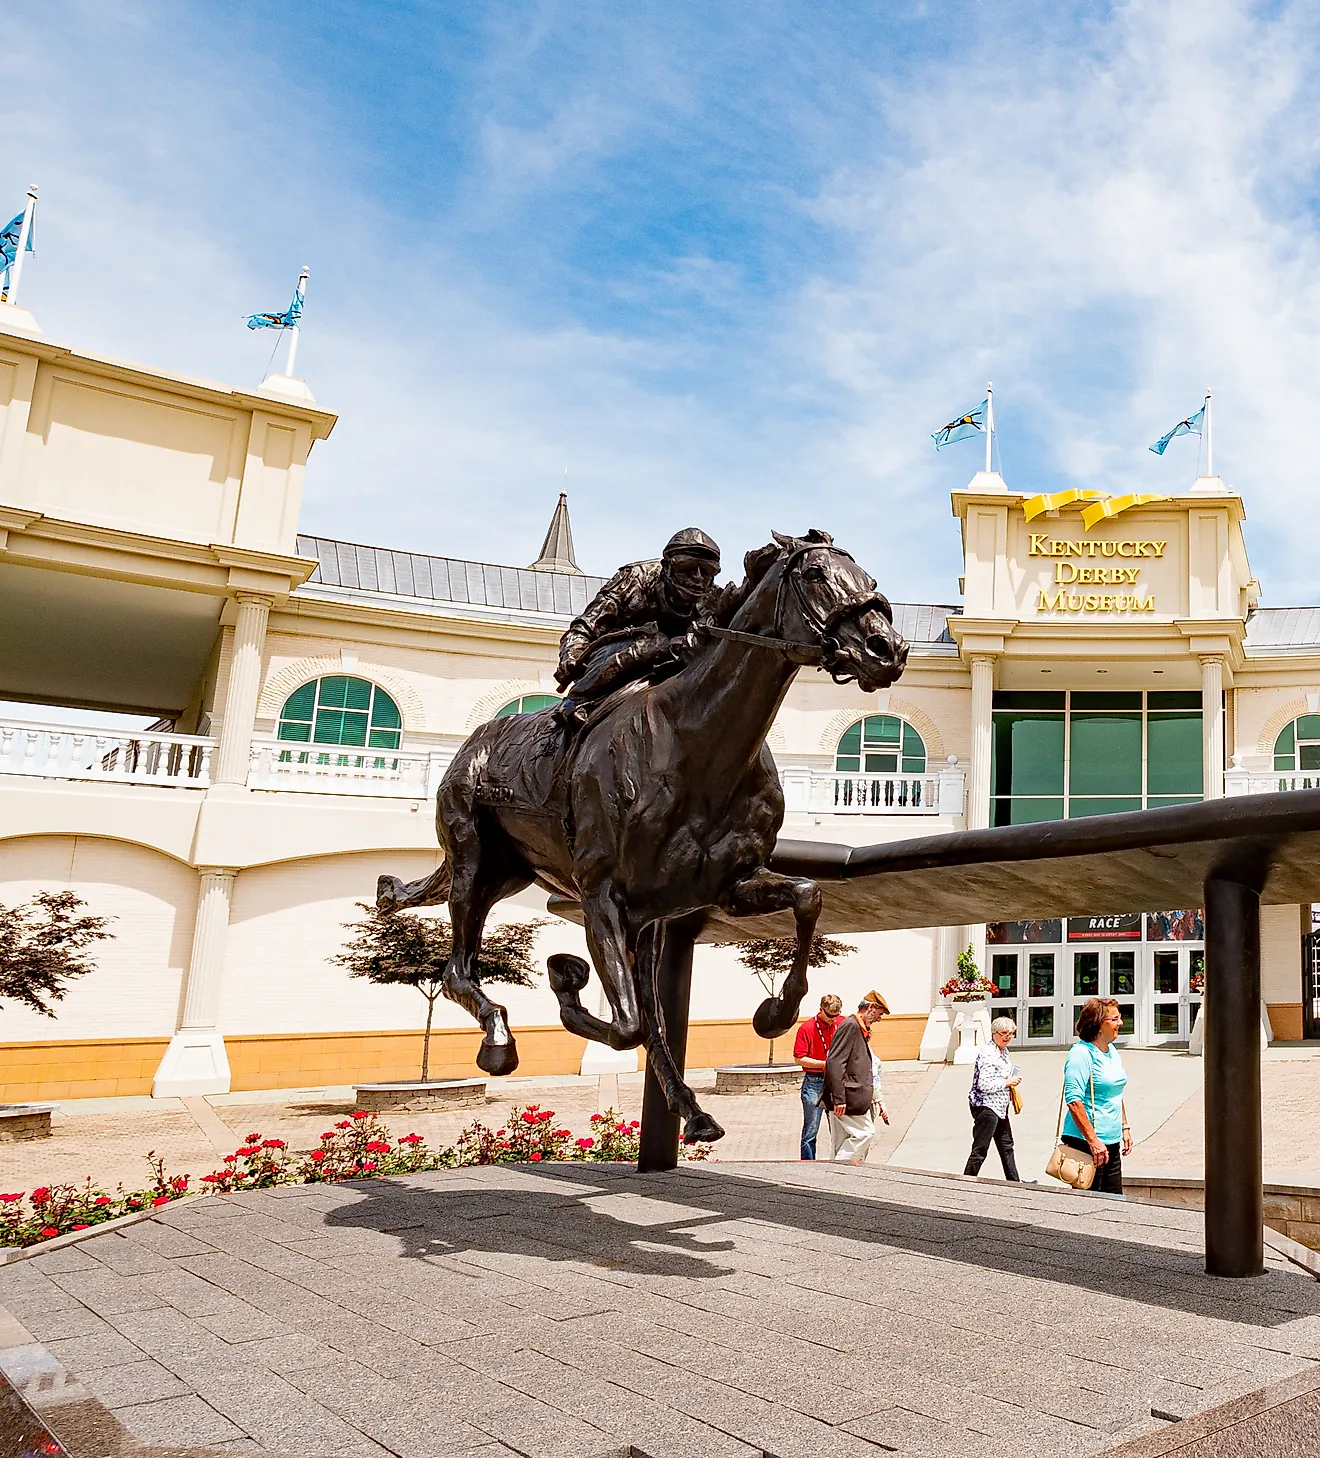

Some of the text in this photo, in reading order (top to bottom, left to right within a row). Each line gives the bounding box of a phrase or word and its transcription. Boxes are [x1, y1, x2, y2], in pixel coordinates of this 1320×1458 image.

[1028, 532, 1167, 557] KENTUCKY
[1055, 561, 1140, 585] DERBY
[1037, 589, 1156, 613] MUSEUM
[1089, 918, 1121, 929] RACE
